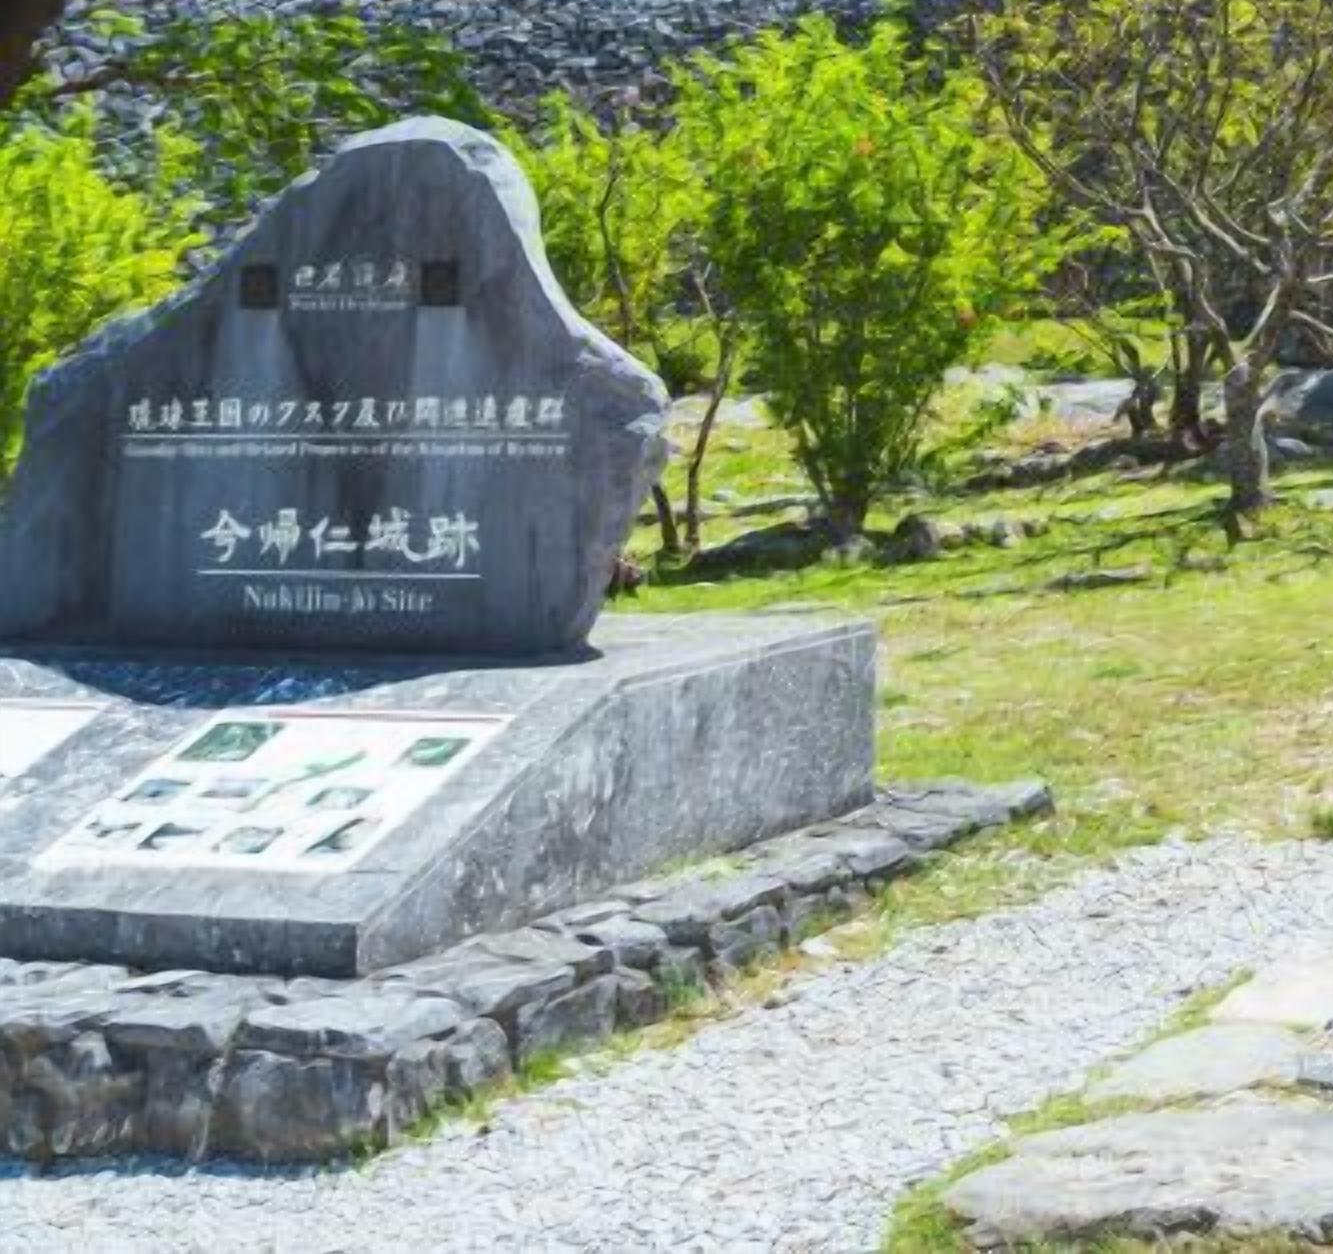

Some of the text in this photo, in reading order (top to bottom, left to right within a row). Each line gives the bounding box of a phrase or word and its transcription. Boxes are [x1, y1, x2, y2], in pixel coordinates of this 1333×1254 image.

[199, 505, 481, 568] 今帰仁城跡
[380, 587, 435, 614] Site
